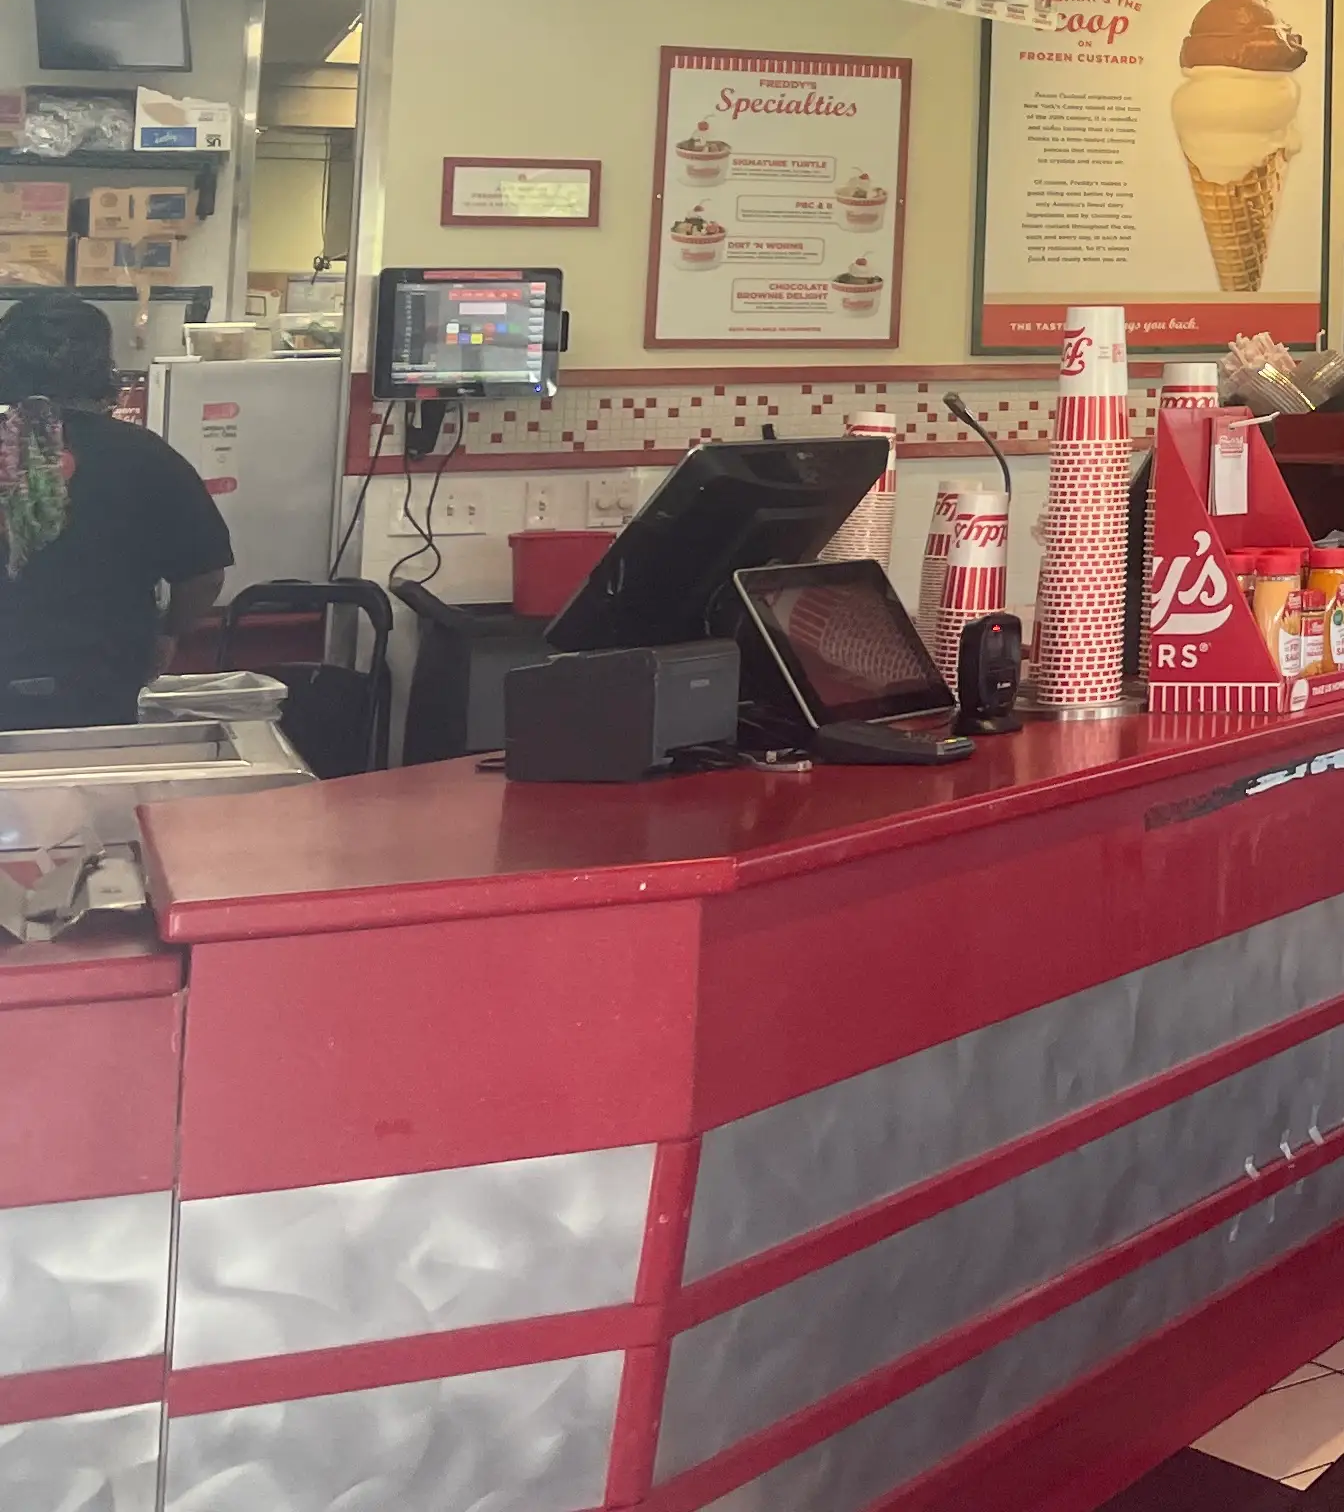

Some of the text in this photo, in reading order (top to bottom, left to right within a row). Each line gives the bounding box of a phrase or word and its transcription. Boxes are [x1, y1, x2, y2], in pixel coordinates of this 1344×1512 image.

[1019, 51, 1144, 65] FROZEN CUSTARD?
[759, 78, 817, 90] FREDDY'S
[715, 87, 857, 120] Specialties
[732, 157, 827, 169] SIGNATURE TURTLE
[727, 241, 804, 250] DIRT WORMS
[768, 282, 829, 291] CHOCOLATE
[736, 291, 829, 300] BROWNIE DELIGHT
[1010, 323, 1032, 331] THE
[1143, 320, 1166, 335] you
[1168, 317, 1199, 331] back.
